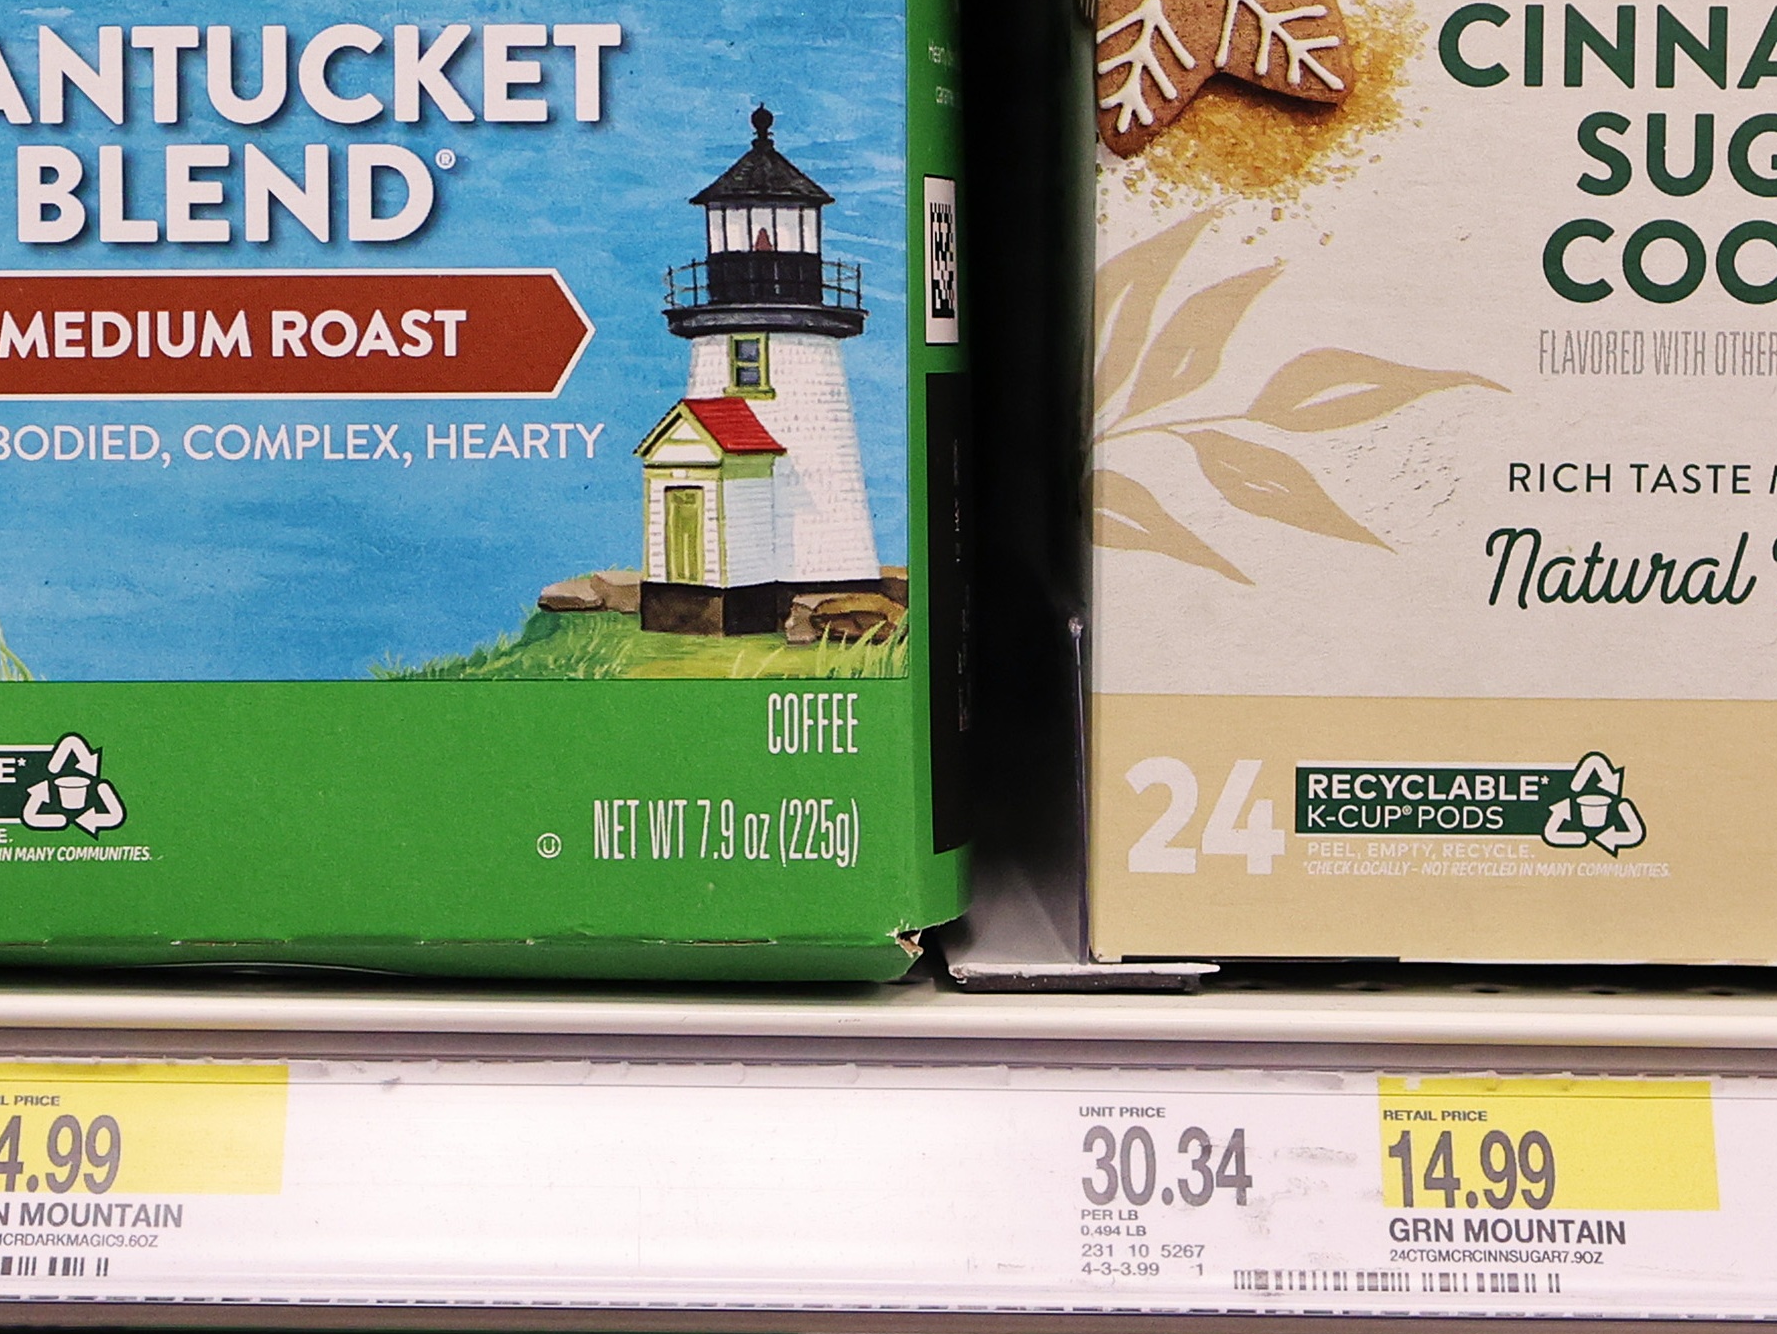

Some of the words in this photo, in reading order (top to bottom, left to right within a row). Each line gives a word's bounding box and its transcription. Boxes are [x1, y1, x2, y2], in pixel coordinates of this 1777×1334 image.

[272, 309, 467, 358] ROAST
[1539, 329, 1645, 375] FLAVORED
[1653, 330, 1704, 375] WITH
[184, 424, 414, 467] COMPLEX,
[427, 423, 606, 459] HEARTY
[1509, 463, 1612, 494] RICH
[1629, 464, 1752, 495] TASTE
[1485, 527, 1757, 610] Natural
[767, 693, 859, 755] COFFEE
[593, 799, 639, 859] NET
[648, 799, 687, 859] WT
[696, 799, 735, 860] 7.9
[779, 798, 860, 868] (225g)
[1125, 756, 1286, 875] 24
[13, 1095, 60, 1107] PRICE
[1079, 1106, 1115, 1118] UNIT
[1119, 1106, 1166, 1118] PRICE
[1383, 1110, 1437, 1121] RETAIL
[1441, 1110, 1488, 1121] PRICE
[1081, 1125, 1253, 1208] 30.34
[1388, 1130, 1556, 1211] 14.99
[19, 1202, 183, 1229] MOUNTAIN
[1389, 1218, 1454, 1244] GRN
[1463, 1218, 1626, 1246] MOUNTAIN
